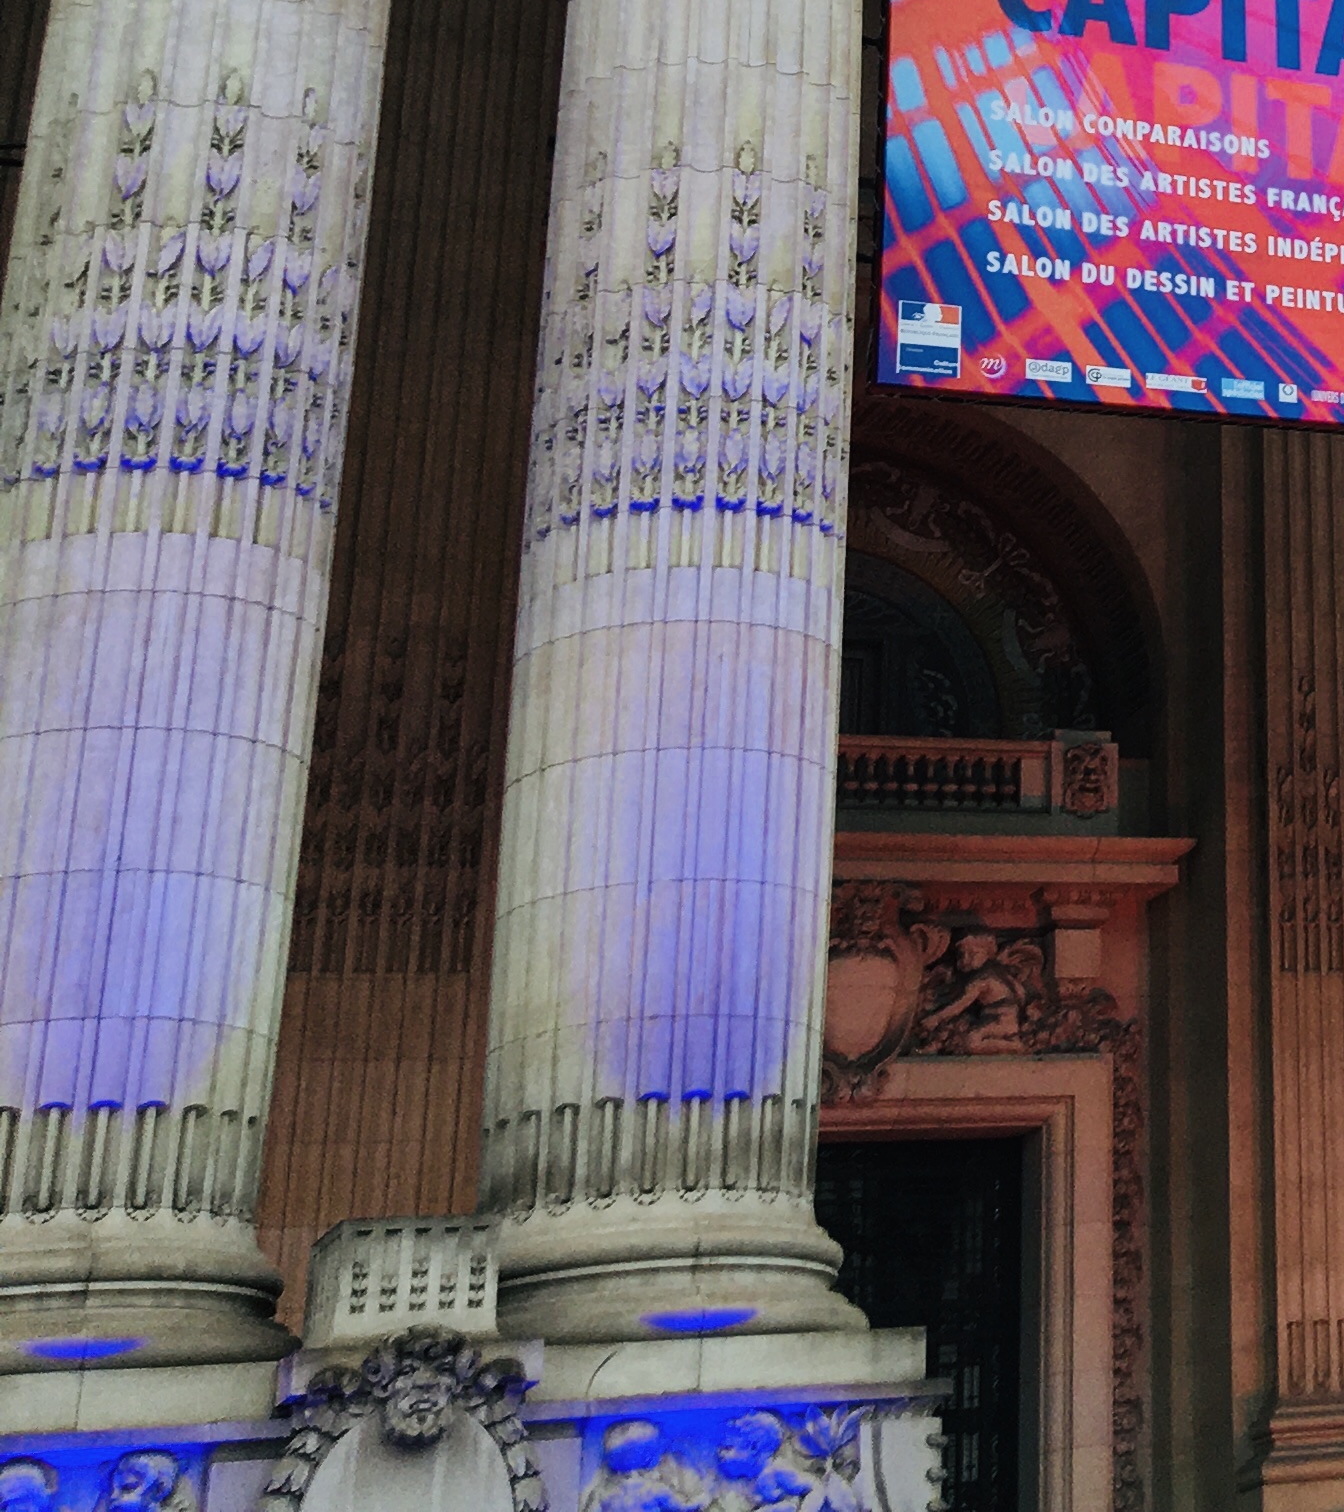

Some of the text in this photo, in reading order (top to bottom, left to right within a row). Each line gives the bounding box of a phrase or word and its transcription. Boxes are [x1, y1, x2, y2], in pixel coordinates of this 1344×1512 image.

[990, 100, 1271, 159] SALON COMPARAISONS
[988, 149, 1073, 180] SALON
[1083, 163, 1129, 188] DES
[1140, 171, 1257, 205] ARTISTES
[987, 199, 1072, 231] SALON
[1082, 211, 1129, 238] DES
[1140, 220, 1257, 254] ARTISTES
[986, 251, 1070, 281] SALON
[1081, 262, 1115, 286] DU
[1126, 268, 1215, 299] DESSIN
[1226, 280, 1255, 303] ET
